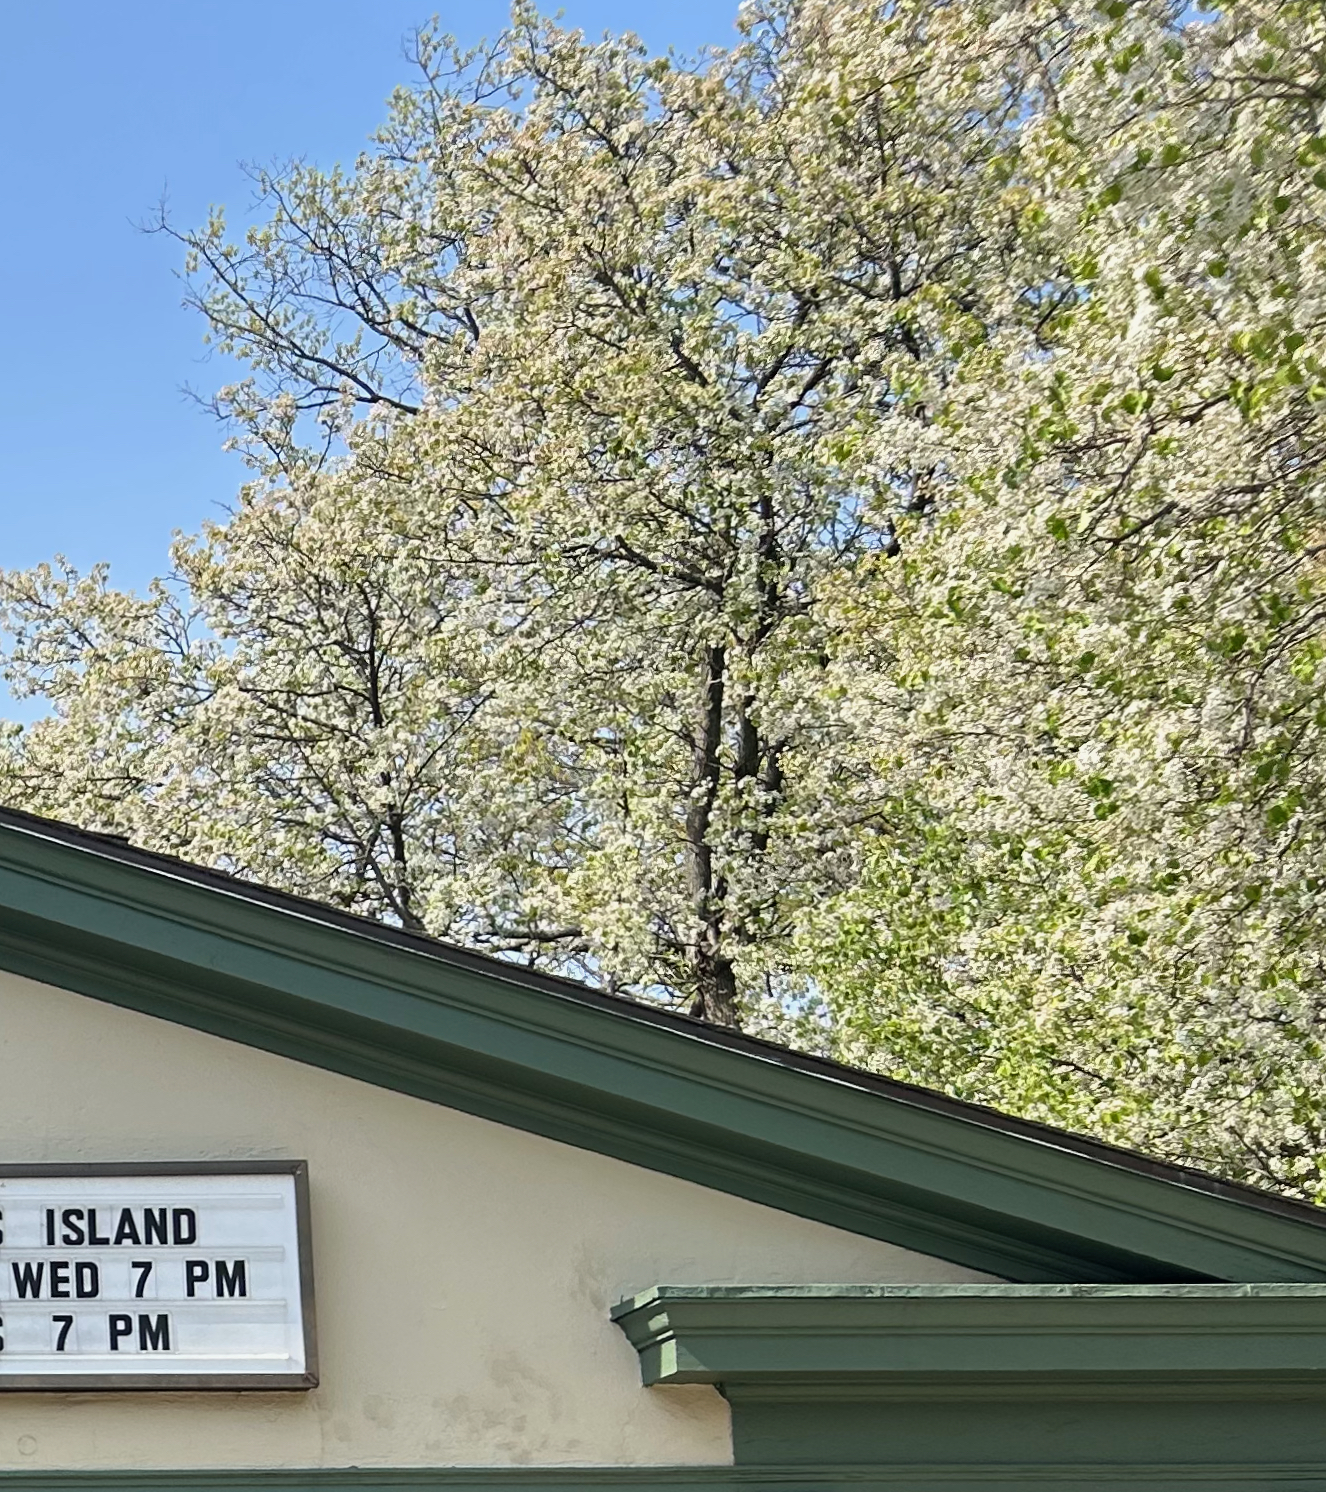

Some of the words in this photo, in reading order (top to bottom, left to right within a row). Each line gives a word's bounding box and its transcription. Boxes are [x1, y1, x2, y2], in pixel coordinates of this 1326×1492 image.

[45, 1207, 198, 1246] ISLAND
[11, 1261, 100, 1299] WED
[130, 1260, 153, 1298] 7
[185, 1260, 247, 1297] PM
[52, 1315, 74, 1352] 7
[108, 1313, 172, 1352] PM
